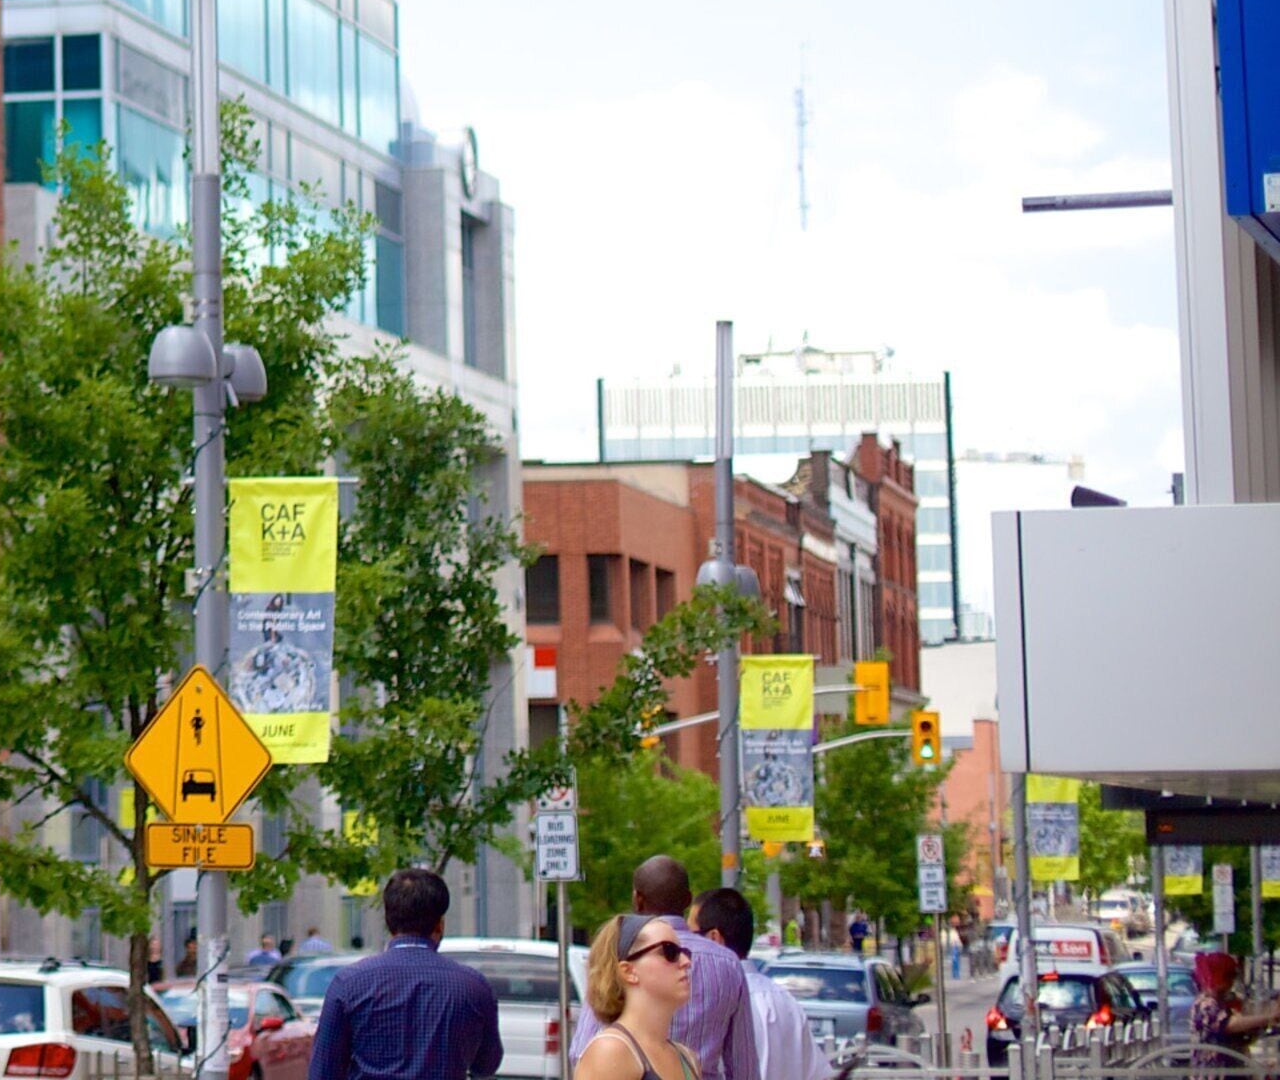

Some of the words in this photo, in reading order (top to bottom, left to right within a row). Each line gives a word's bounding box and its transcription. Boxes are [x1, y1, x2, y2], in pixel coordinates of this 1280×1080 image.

[260, 503, 306, 522] CAF
[262, 522, 307, 541] K+A
[261, 723, 296, 738] JUNE
[547, 821, 564, 832] BUS
[171, 827, 227, 844] SINGLE
[538, 835, 575, 845] LOADING
[182, 846, 217, 864] FILE
[546, 848, 568, 858] ZONE
[546, 860, 569, 871] ONLY
